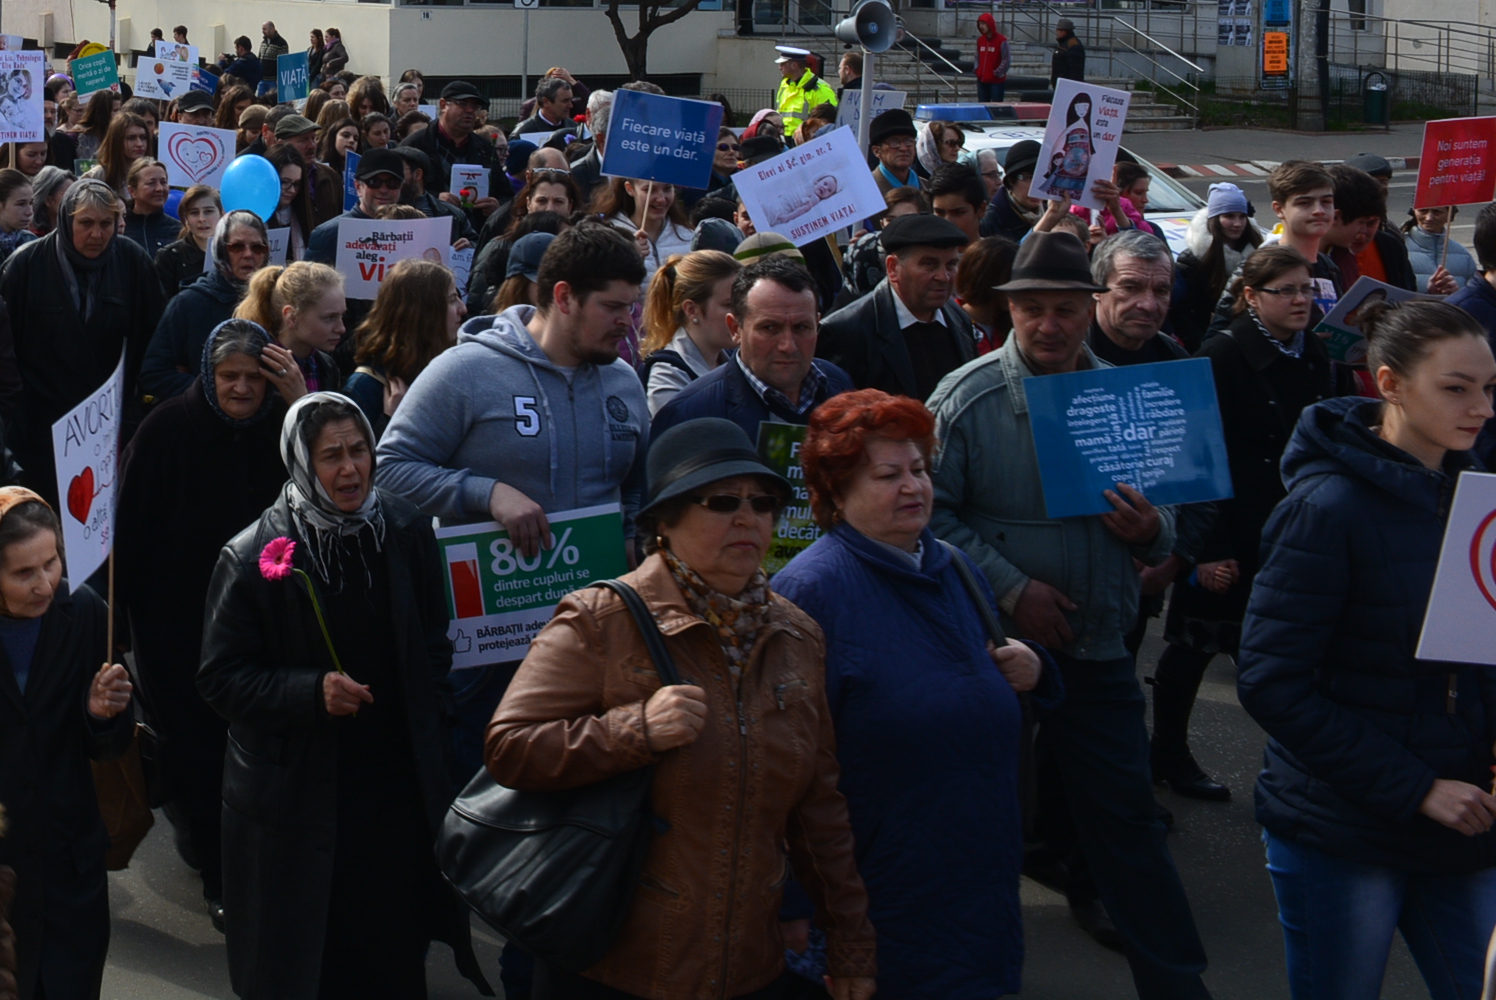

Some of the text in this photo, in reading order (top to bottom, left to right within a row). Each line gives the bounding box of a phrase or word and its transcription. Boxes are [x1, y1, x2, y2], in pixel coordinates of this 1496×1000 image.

[280, 65, 308, 89] VIAȚĂ
[1101, 94, 1125, 106] Fiecare
[1095, 117, 1109, 128] este
[621, 117, 706, 147] Fiecare viață
[1102, 132, 1117, 142] dar
[621, 139, 699, 161] este un dar.
[1437, 139, 1489, 152] Noi suntem
[757, 168, 777, 181] Elevi
[778, 163, 786, 173] ai
[827, 142, 833, 152] 2
[1437, 156, 1482, 172] generația
[1429, 169, 1486, 188] pentru viață!
[372, 231, 414, 244] Bărbații
[345, 240, 397, 254] adevărați
[356, 250, 379, 263] aleg
[513, 395, 542, 437] 5
[1066, 403, 1117, 418] dragoste
[1123, 422, 1158, 441] dar
[1074, 433, 1112, 448] mamă
[1107, 442, 1127, 453] tată
[1097, 459, 1145, 473] căsătorie
[1145, 453, 1175, 468] curaj
[777, 520, 821, 541] decât
[493, 569, 590, 593] dintre cupluri se
[495, 592, 542, 609] despart
[476, 623, 524, 639] BĂRBAȚII
[478, 635, 532, 653] protejează
